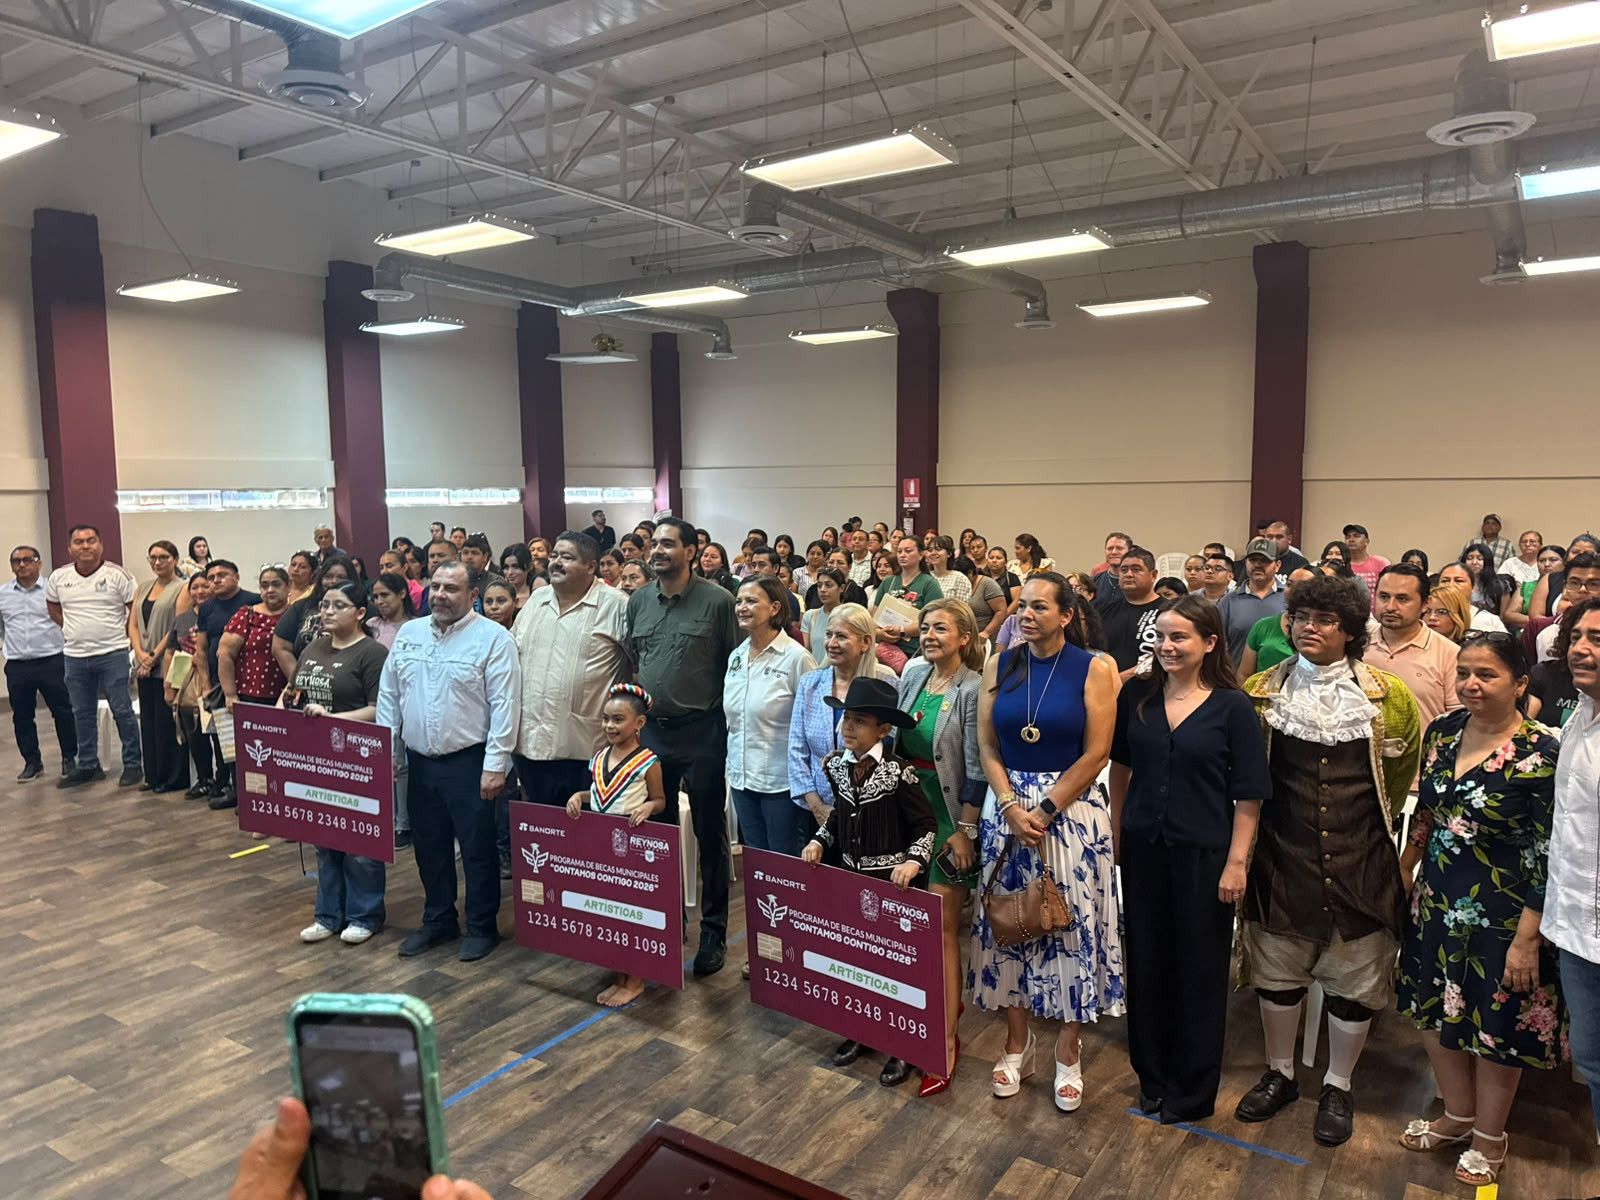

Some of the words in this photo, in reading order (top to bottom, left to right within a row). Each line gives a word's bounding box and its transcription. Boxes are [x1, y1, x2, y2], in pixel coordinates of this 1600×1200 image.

[252, 723, 288, 735] BANORTE
[347, 734, 382, 748] REYNOSA
[272, 750, 306, 762] PROGRAMA
[307, 755, 314, 763] DE
[316, 756, 334, 767] BECAS
[334, 760, 373, 774] MUNICIPALES
[317, 767, 349, 779] CONTIGO
[305, 787, 360, 807] ARTÍSTICAS
[252, 800, 280, 816] 1234
[284, 806, 314, 822] 5678
[318, 812, 346, 830] 2348
[352, 820, 381, 838] 1098
[529, 824, 566, 838] BANORTE
[630, 836, 670, 851] REYNOSA
[550, 854, 585, 868] PROGRAMA
[586, 861, 594, 870] DE
[596, 863, 615, 874] BECAS
[616, 866, 659, 882] MUNICIPALES
[597, 873, 632, 888] CONTIGO
[765, 874, 806, 892] BANORTE
[584, 899, 644, 920] ARTÍSTICAS
[882, 900, 930, 922] REYNOSA
[528, 910, 557, 928] 1234
[561, 918, 592, 937] 5678
[598, 926, 629, 946] 2348
[634, 936, 666, 956] 1098
[788, 908, 829, 928] PROGRAMA
[830, 920, 840, 931] DE
[841, 924, 864, 938] BECAS
[866, 930, 917, 956] MUNICIPALES
[844, 936, 886, 956] CONTIGO
[828, 963, 898, 996] ARTÍSTICAS
[764, 967, 798, 991] 1234
[804, 980, 839, 1006] 5678
[844, 995, 882, 1022] 2348
[888, 1012, 928, 1040] 1098
